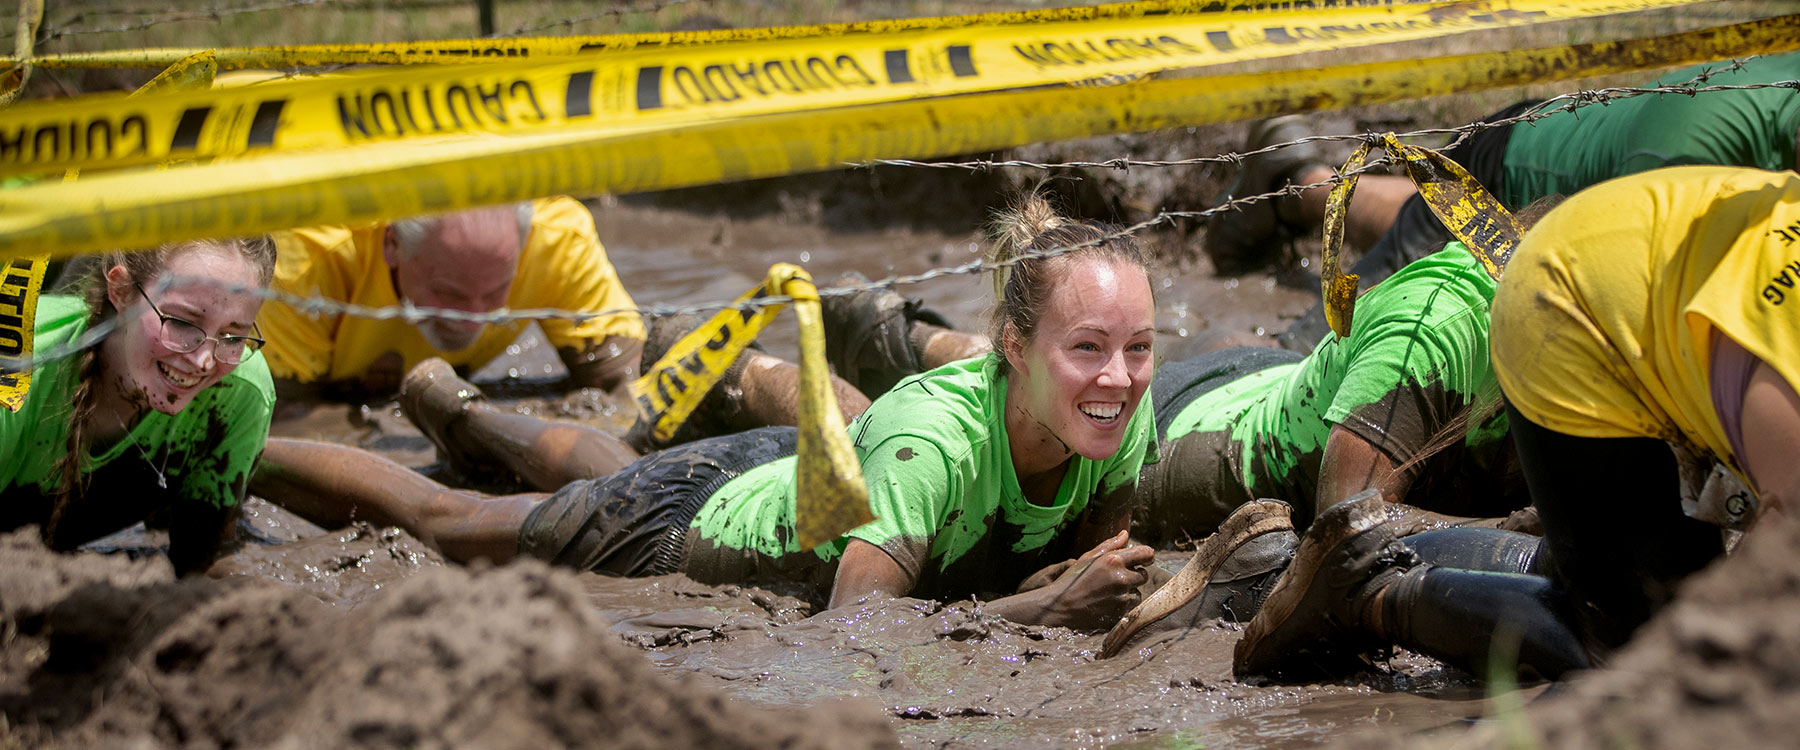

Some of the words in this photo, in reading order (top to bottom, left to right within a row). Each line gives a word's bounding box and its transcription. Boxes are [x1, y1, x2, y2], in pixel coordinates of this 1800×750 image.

[1012, 35, 1201, 71] CAUTION
[672, 54, 876, 103] CUIDADO
[336, 80, 546, 139] CAUTION
